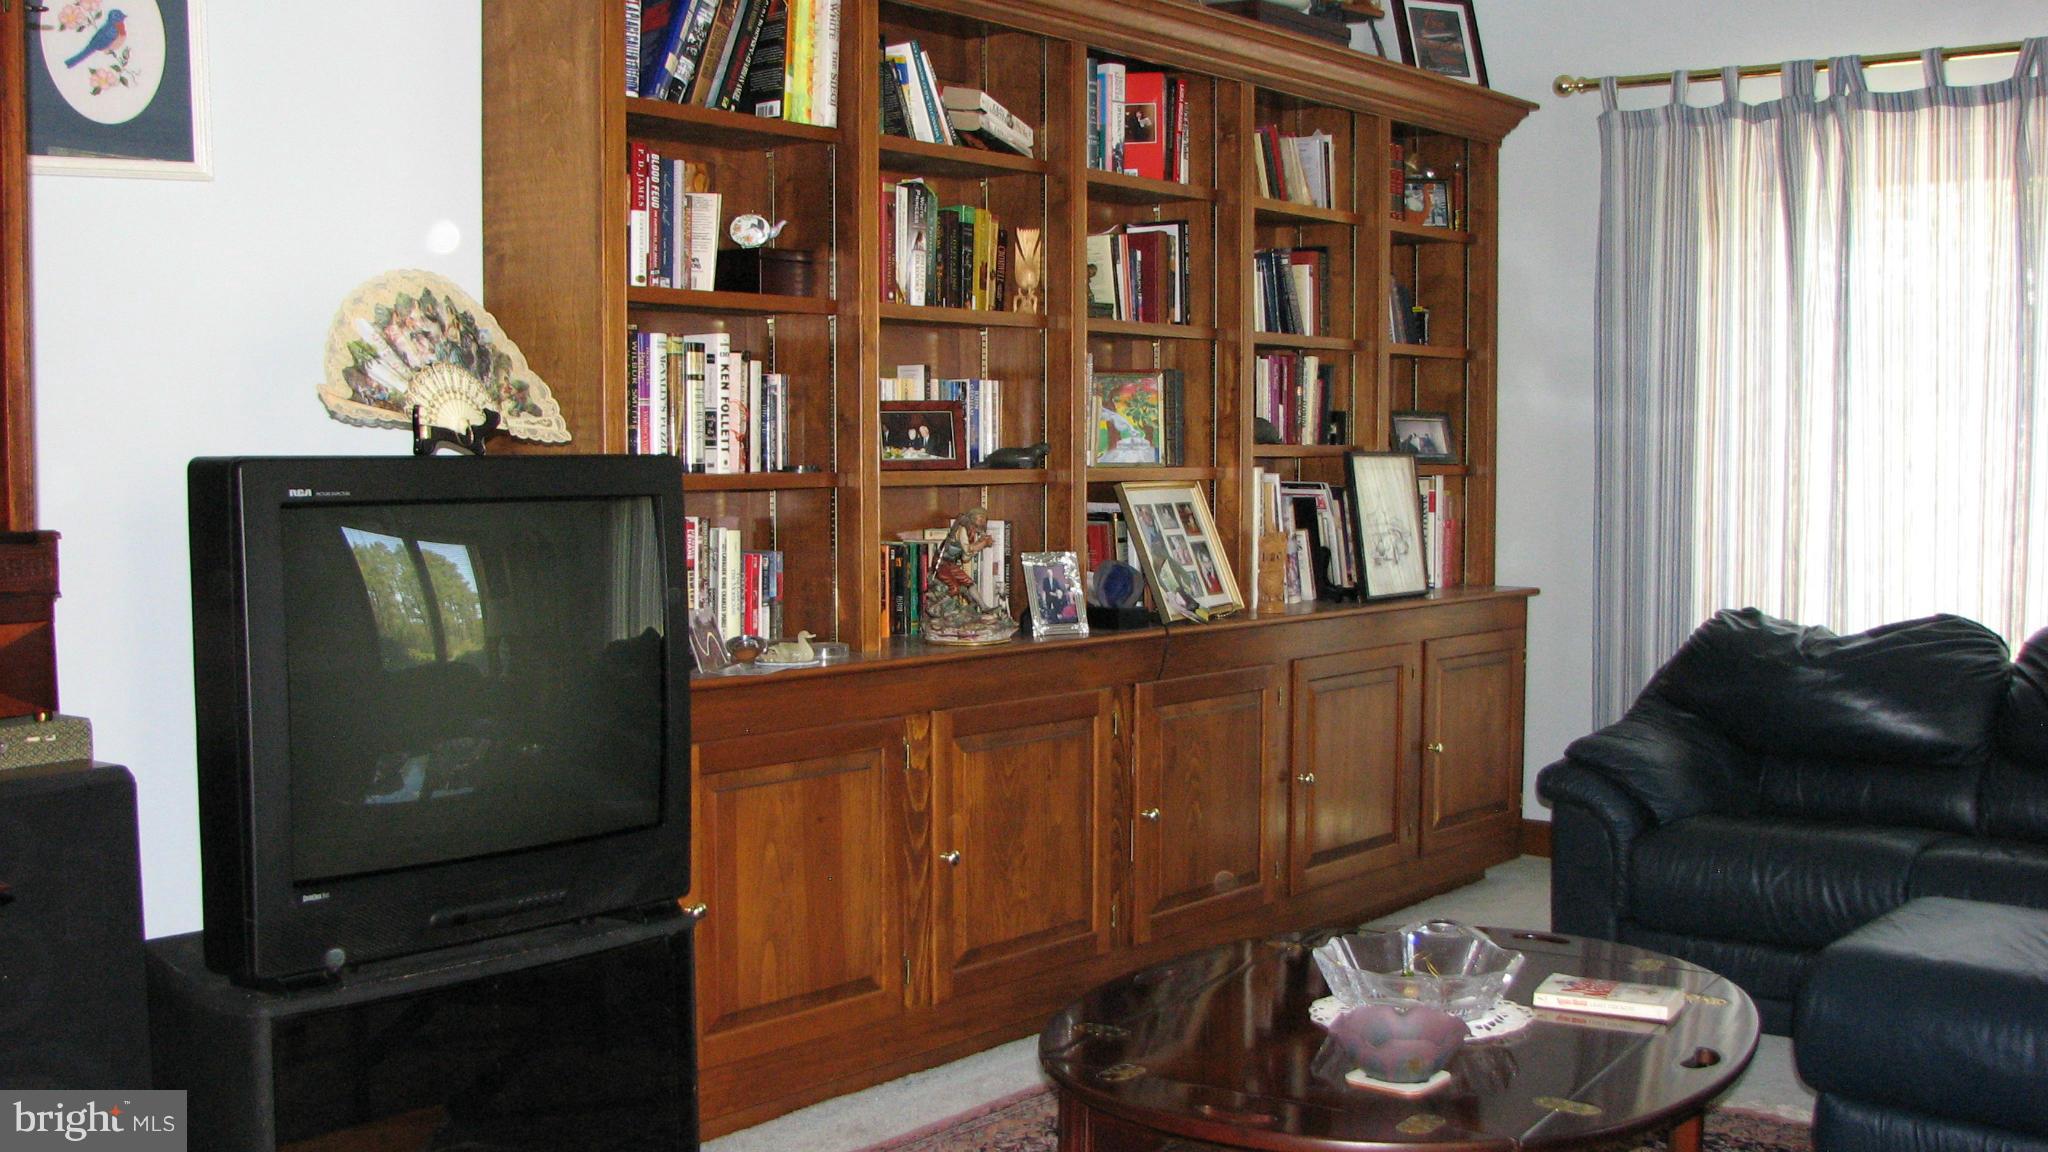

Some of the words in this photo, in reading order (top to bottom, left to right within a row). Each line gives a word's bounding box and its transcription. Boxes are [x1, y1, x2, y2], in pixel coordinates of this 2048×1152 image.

[829, 2, 838, 40] WHITE
[638, 158, 645, 170] D.
[651, 153, 660, 182] BLOOD
[636, 172, 645, 207] JAMES
[651, 184, 660, 209] FEUD
[721, 364, 730, 390] KEN
[721, 396, 730, 453] FOLLETT
[288, 489, 313, 497] RCA
